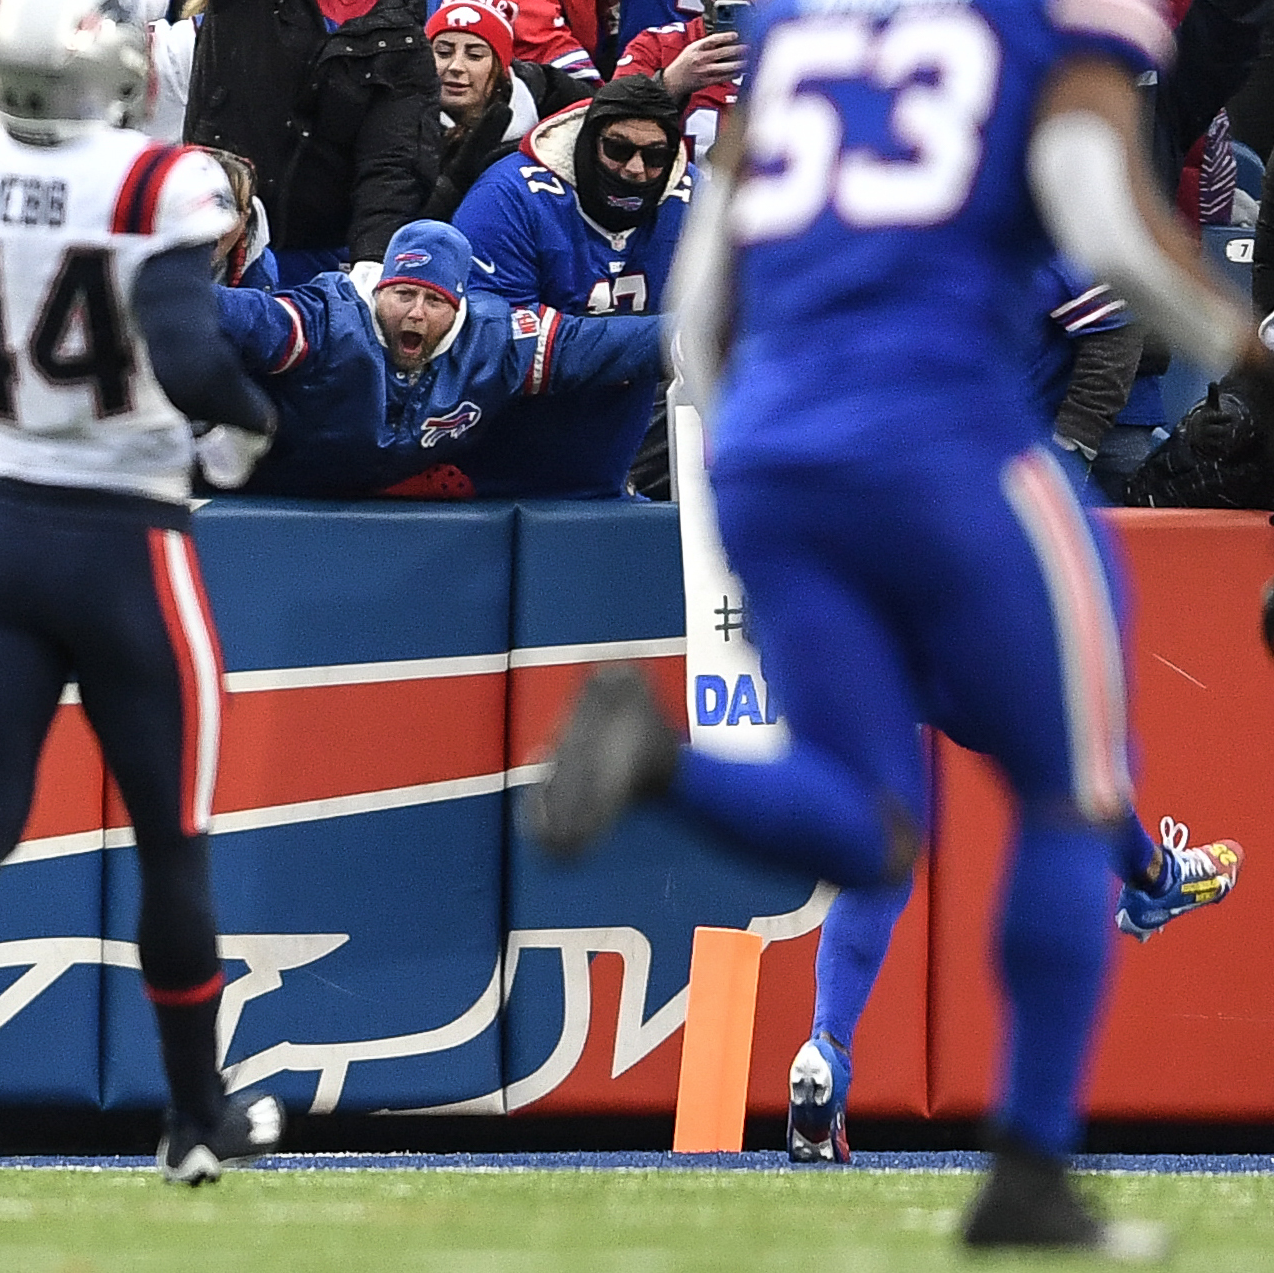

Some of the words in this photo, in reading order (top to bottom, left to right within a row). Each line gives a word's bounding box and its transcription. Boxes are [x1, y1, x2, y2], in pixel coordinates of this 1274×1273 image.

[729, 11, 1000, 244] 53
[518, 164, 565, 196] 17
[1240, 244, 1250, 258] 7
